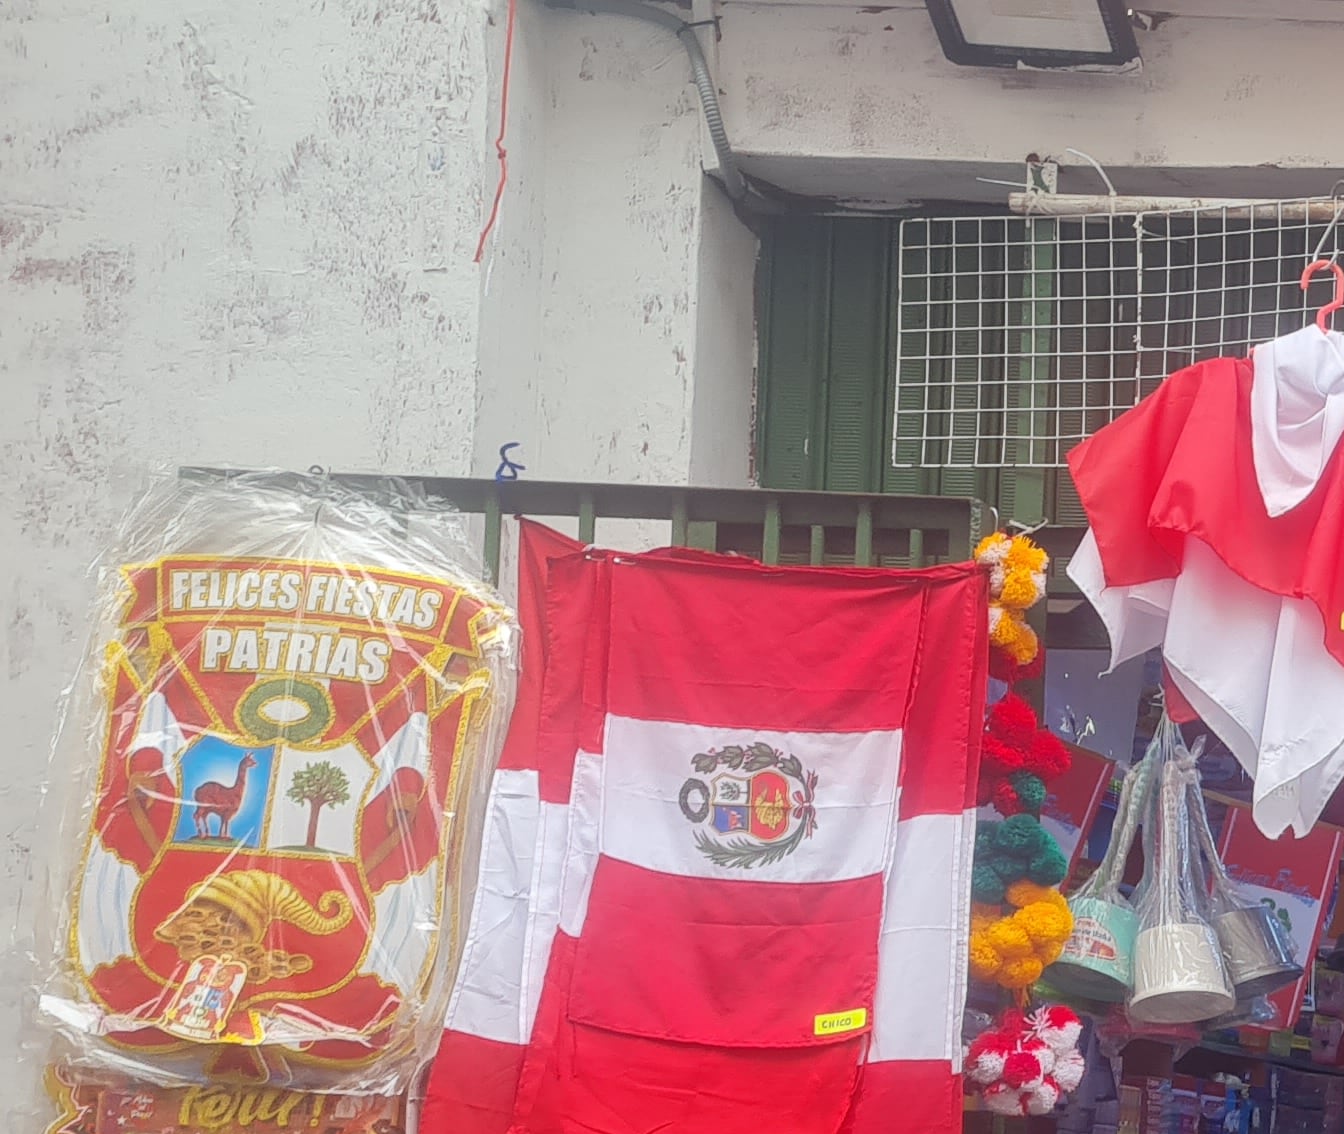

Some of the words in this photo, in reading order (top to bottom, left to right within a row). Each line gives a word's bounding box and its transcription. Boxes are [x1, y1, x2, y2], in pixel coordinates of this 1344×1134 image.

[170, 570, 301, 611] FELICES
[306, 575, 442, 629] FIESTAS
[203, 628, 391, 683] PATRIAS
[821, 1016, 852, 1030] CHICO
